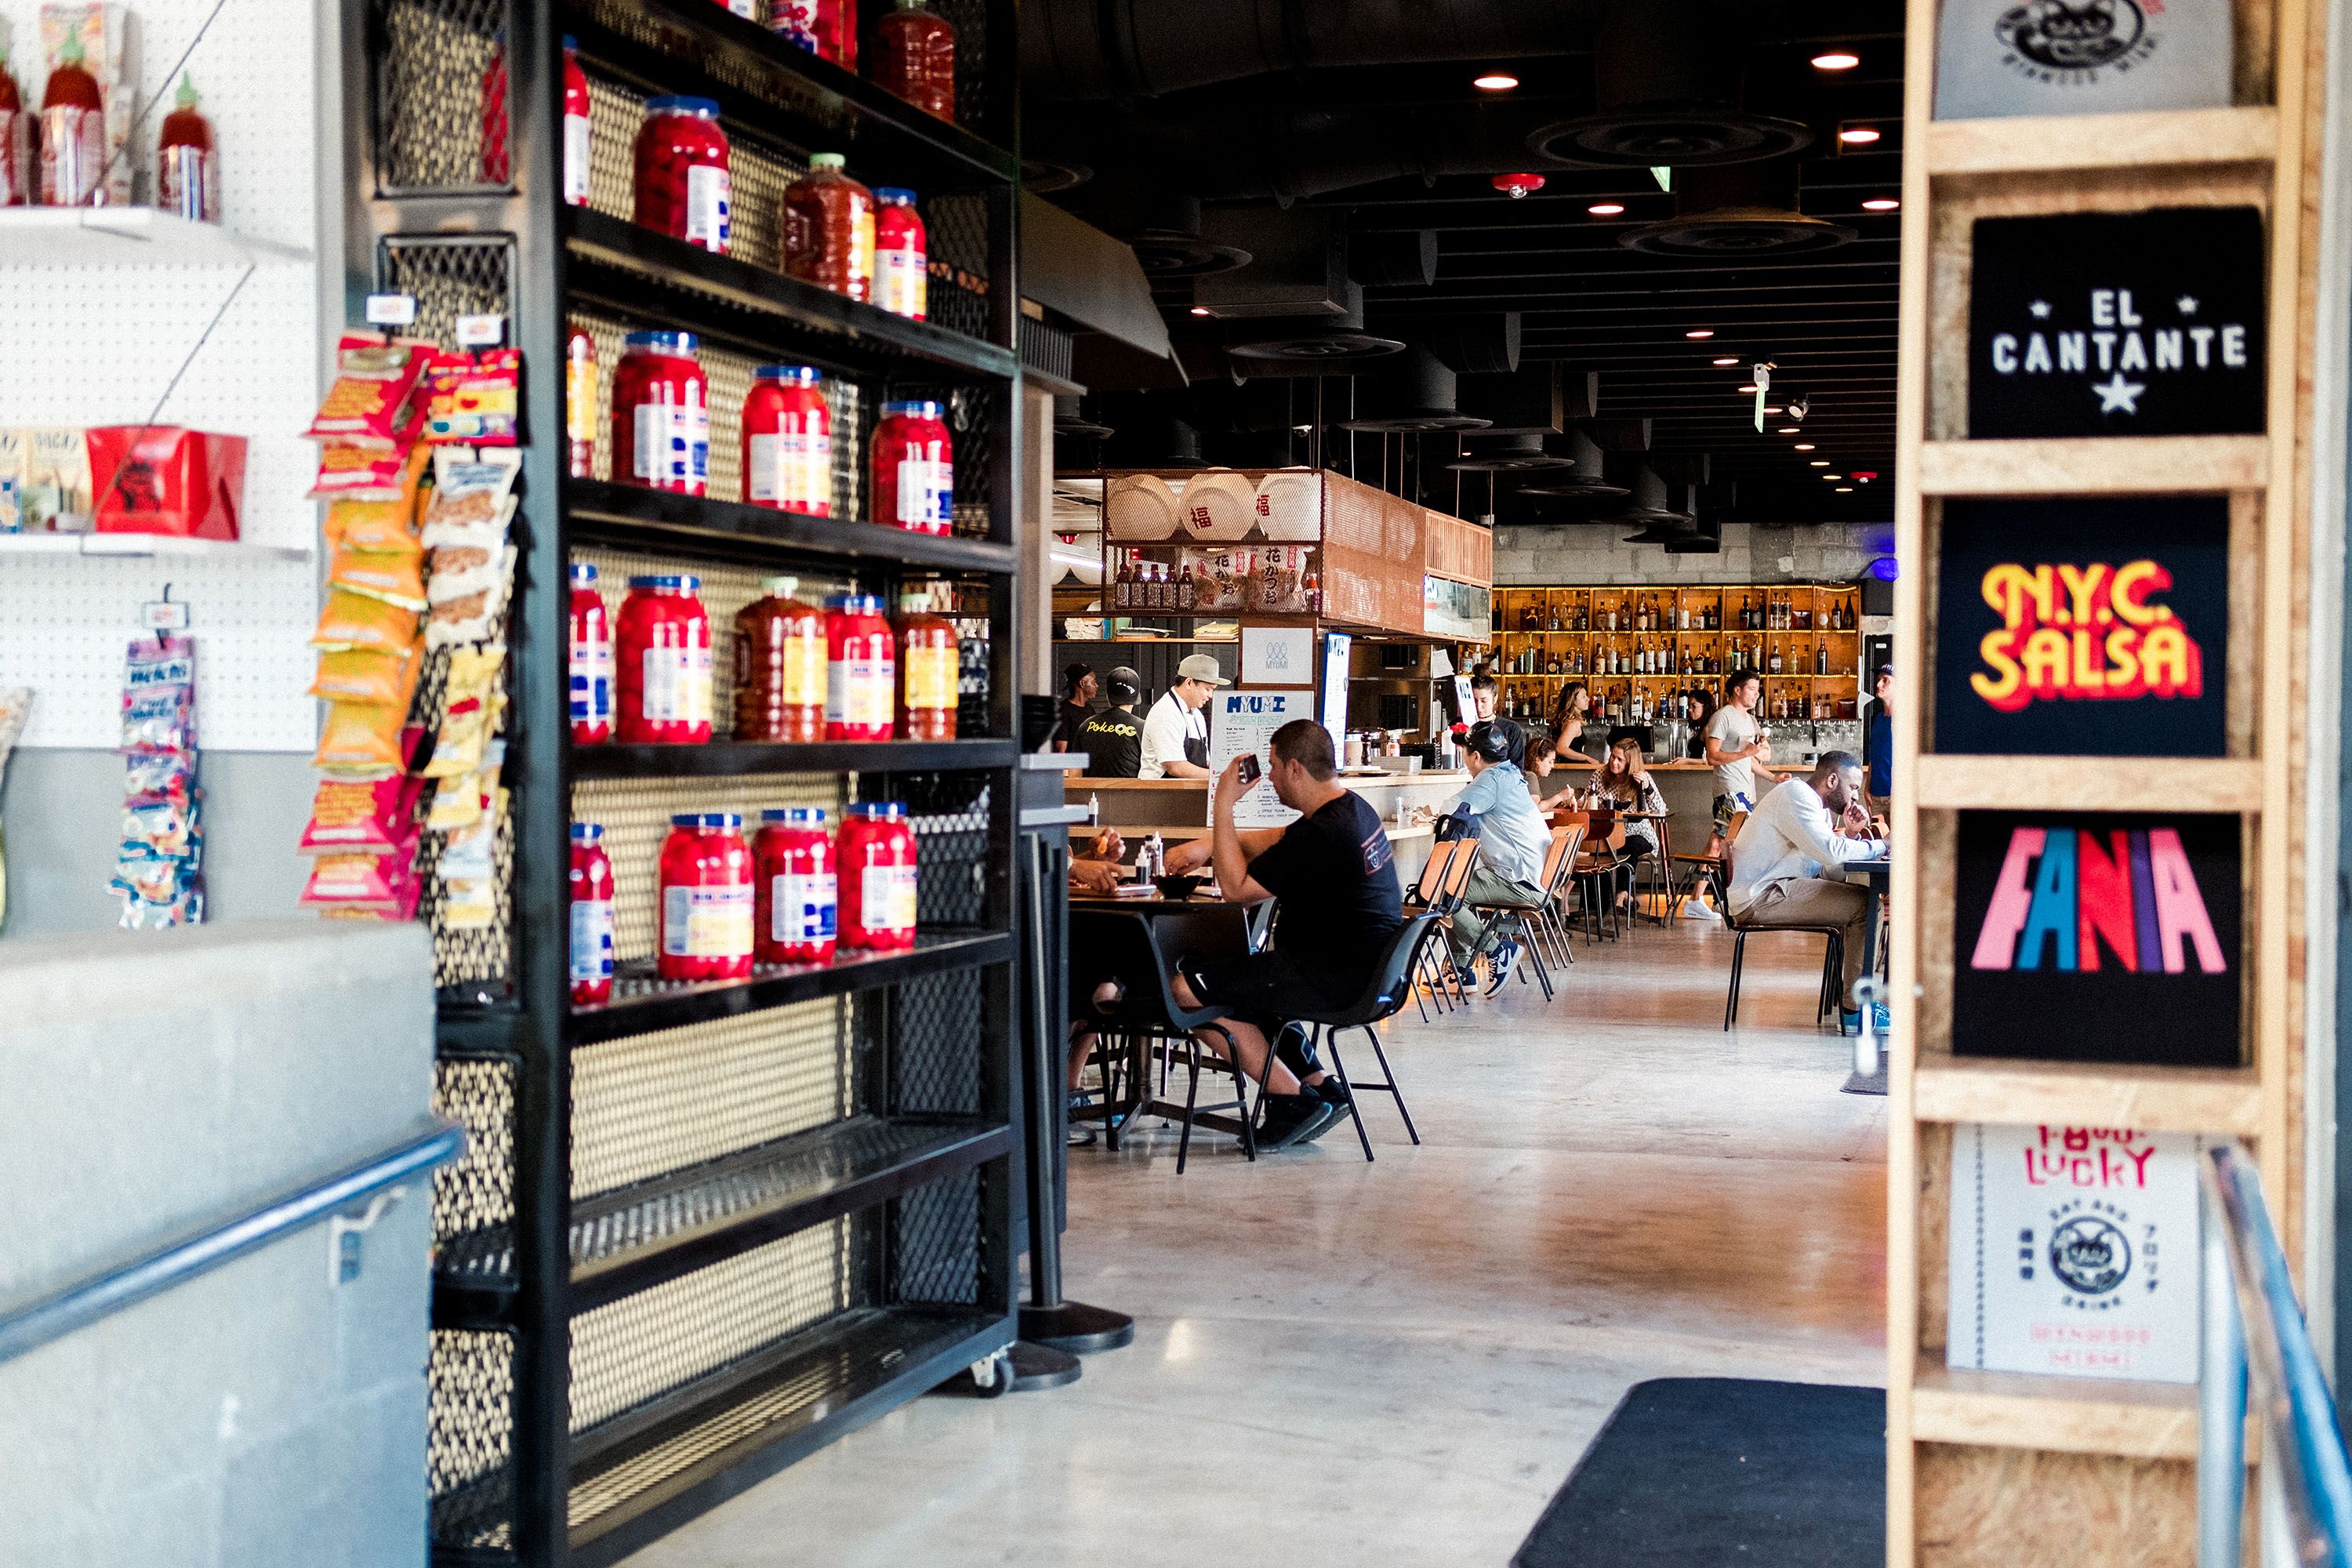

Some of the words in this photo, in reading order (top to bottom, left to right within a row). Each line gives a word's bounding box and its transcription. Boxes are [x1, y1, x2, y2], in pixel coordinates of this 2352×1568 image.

[2091, 289, 2143, 328] EL
[1992, 325, 2248, 374] CANTANTE
[1190, 506, 1212, 529] 福
[1214, 554, 1235, 596] 花かお
[1263, 547, 1281, 605] 花かつお
[1981, 559, 2180, 630] N.Y.C.
[1265, 659, 1288, 670] MYUMI
[1969, 626, 2198, 706] SALSA
[1227, 695, 1286, 713] MYUMI
[1970, 826, 2227, 975] FANIA
